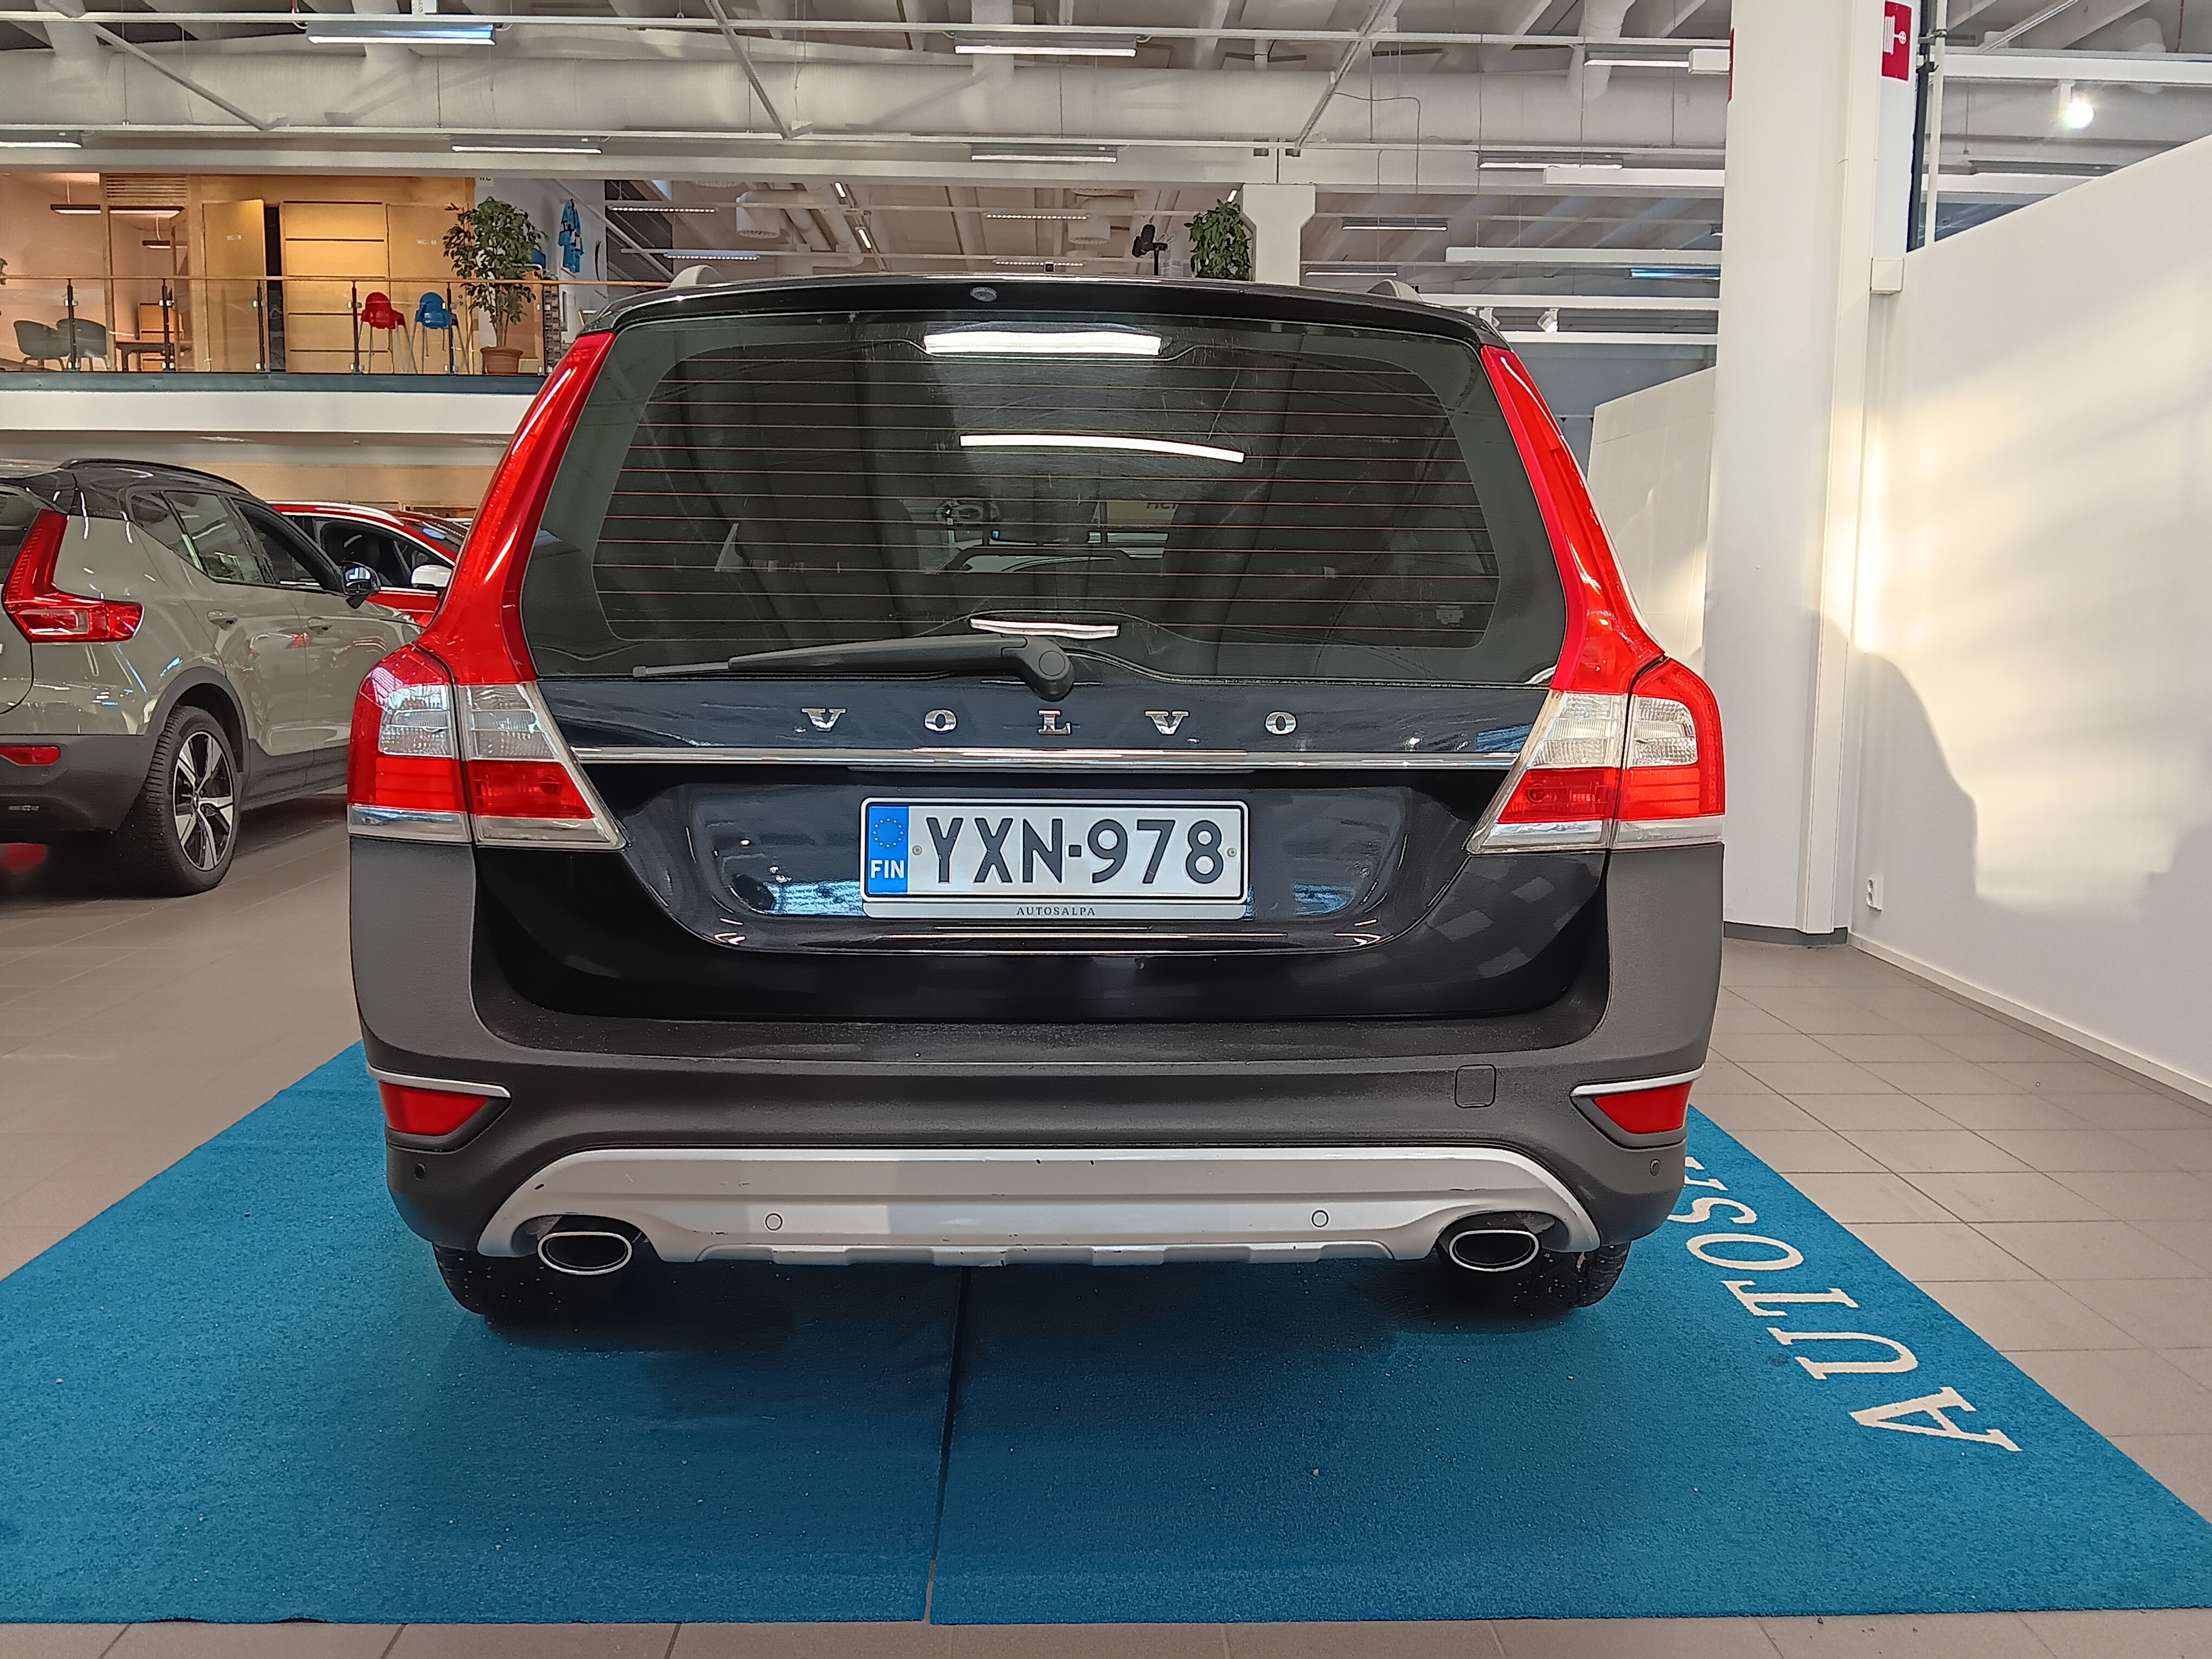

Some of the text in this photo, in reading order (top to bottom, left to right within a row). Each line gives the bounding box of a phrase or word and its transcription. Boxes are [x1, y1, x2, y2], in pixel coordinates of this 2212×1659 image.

[801, 708, 1297, 735] VOLVO
[870, 816, 1224, 885] FIN YXN-978
[1016, 906, 1096, 916] AUTOSALPA
